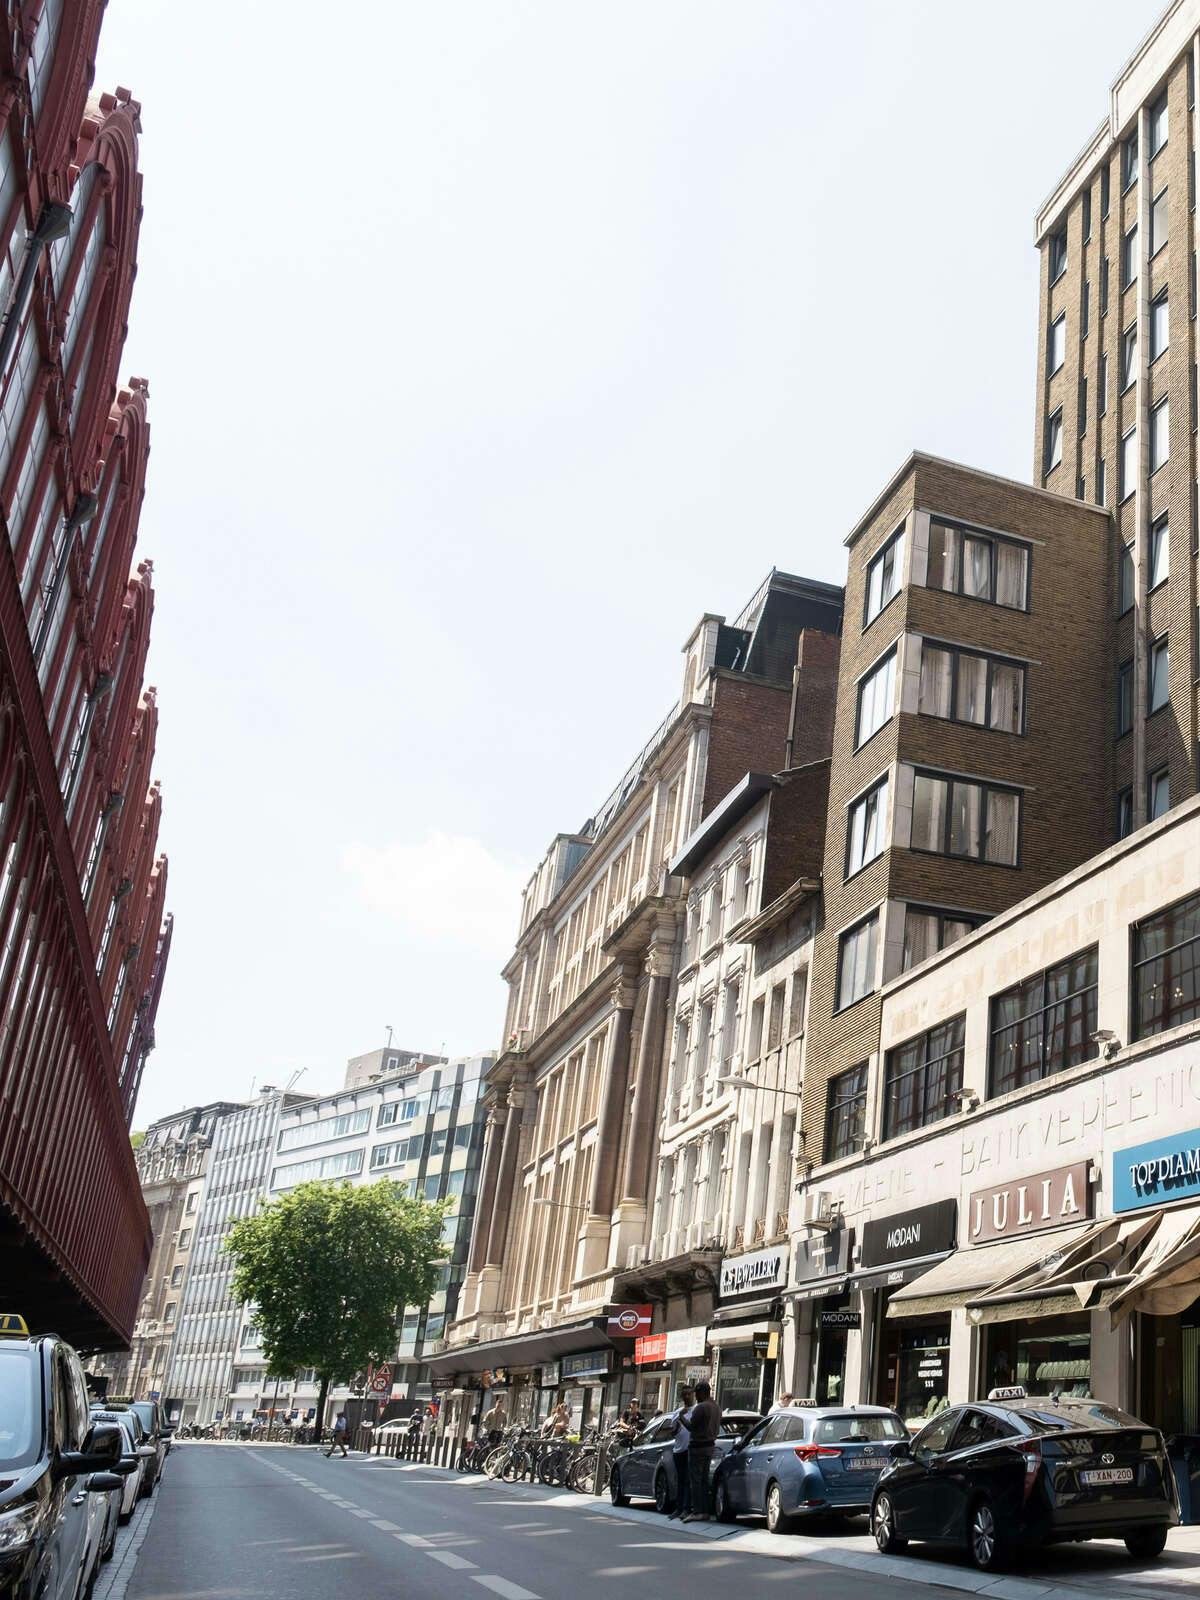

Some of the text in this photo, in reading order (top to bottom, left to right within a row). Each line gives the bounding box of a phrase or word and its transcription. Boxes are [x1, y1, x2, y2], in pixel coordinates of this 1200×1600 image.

[1130, 1160, 1156, 1189] TOP
[972, 1173, 1080, 1237] JULIA
[886, 1223, 921, 1249] MODANI
[735, 1256, 778, 1287] JEWELLERY
[823, 1313, 858, 1323] MODANI
[795, 1399, 817, 1407] TAXI
[996, 1388, 1023, 1398] TAXI
